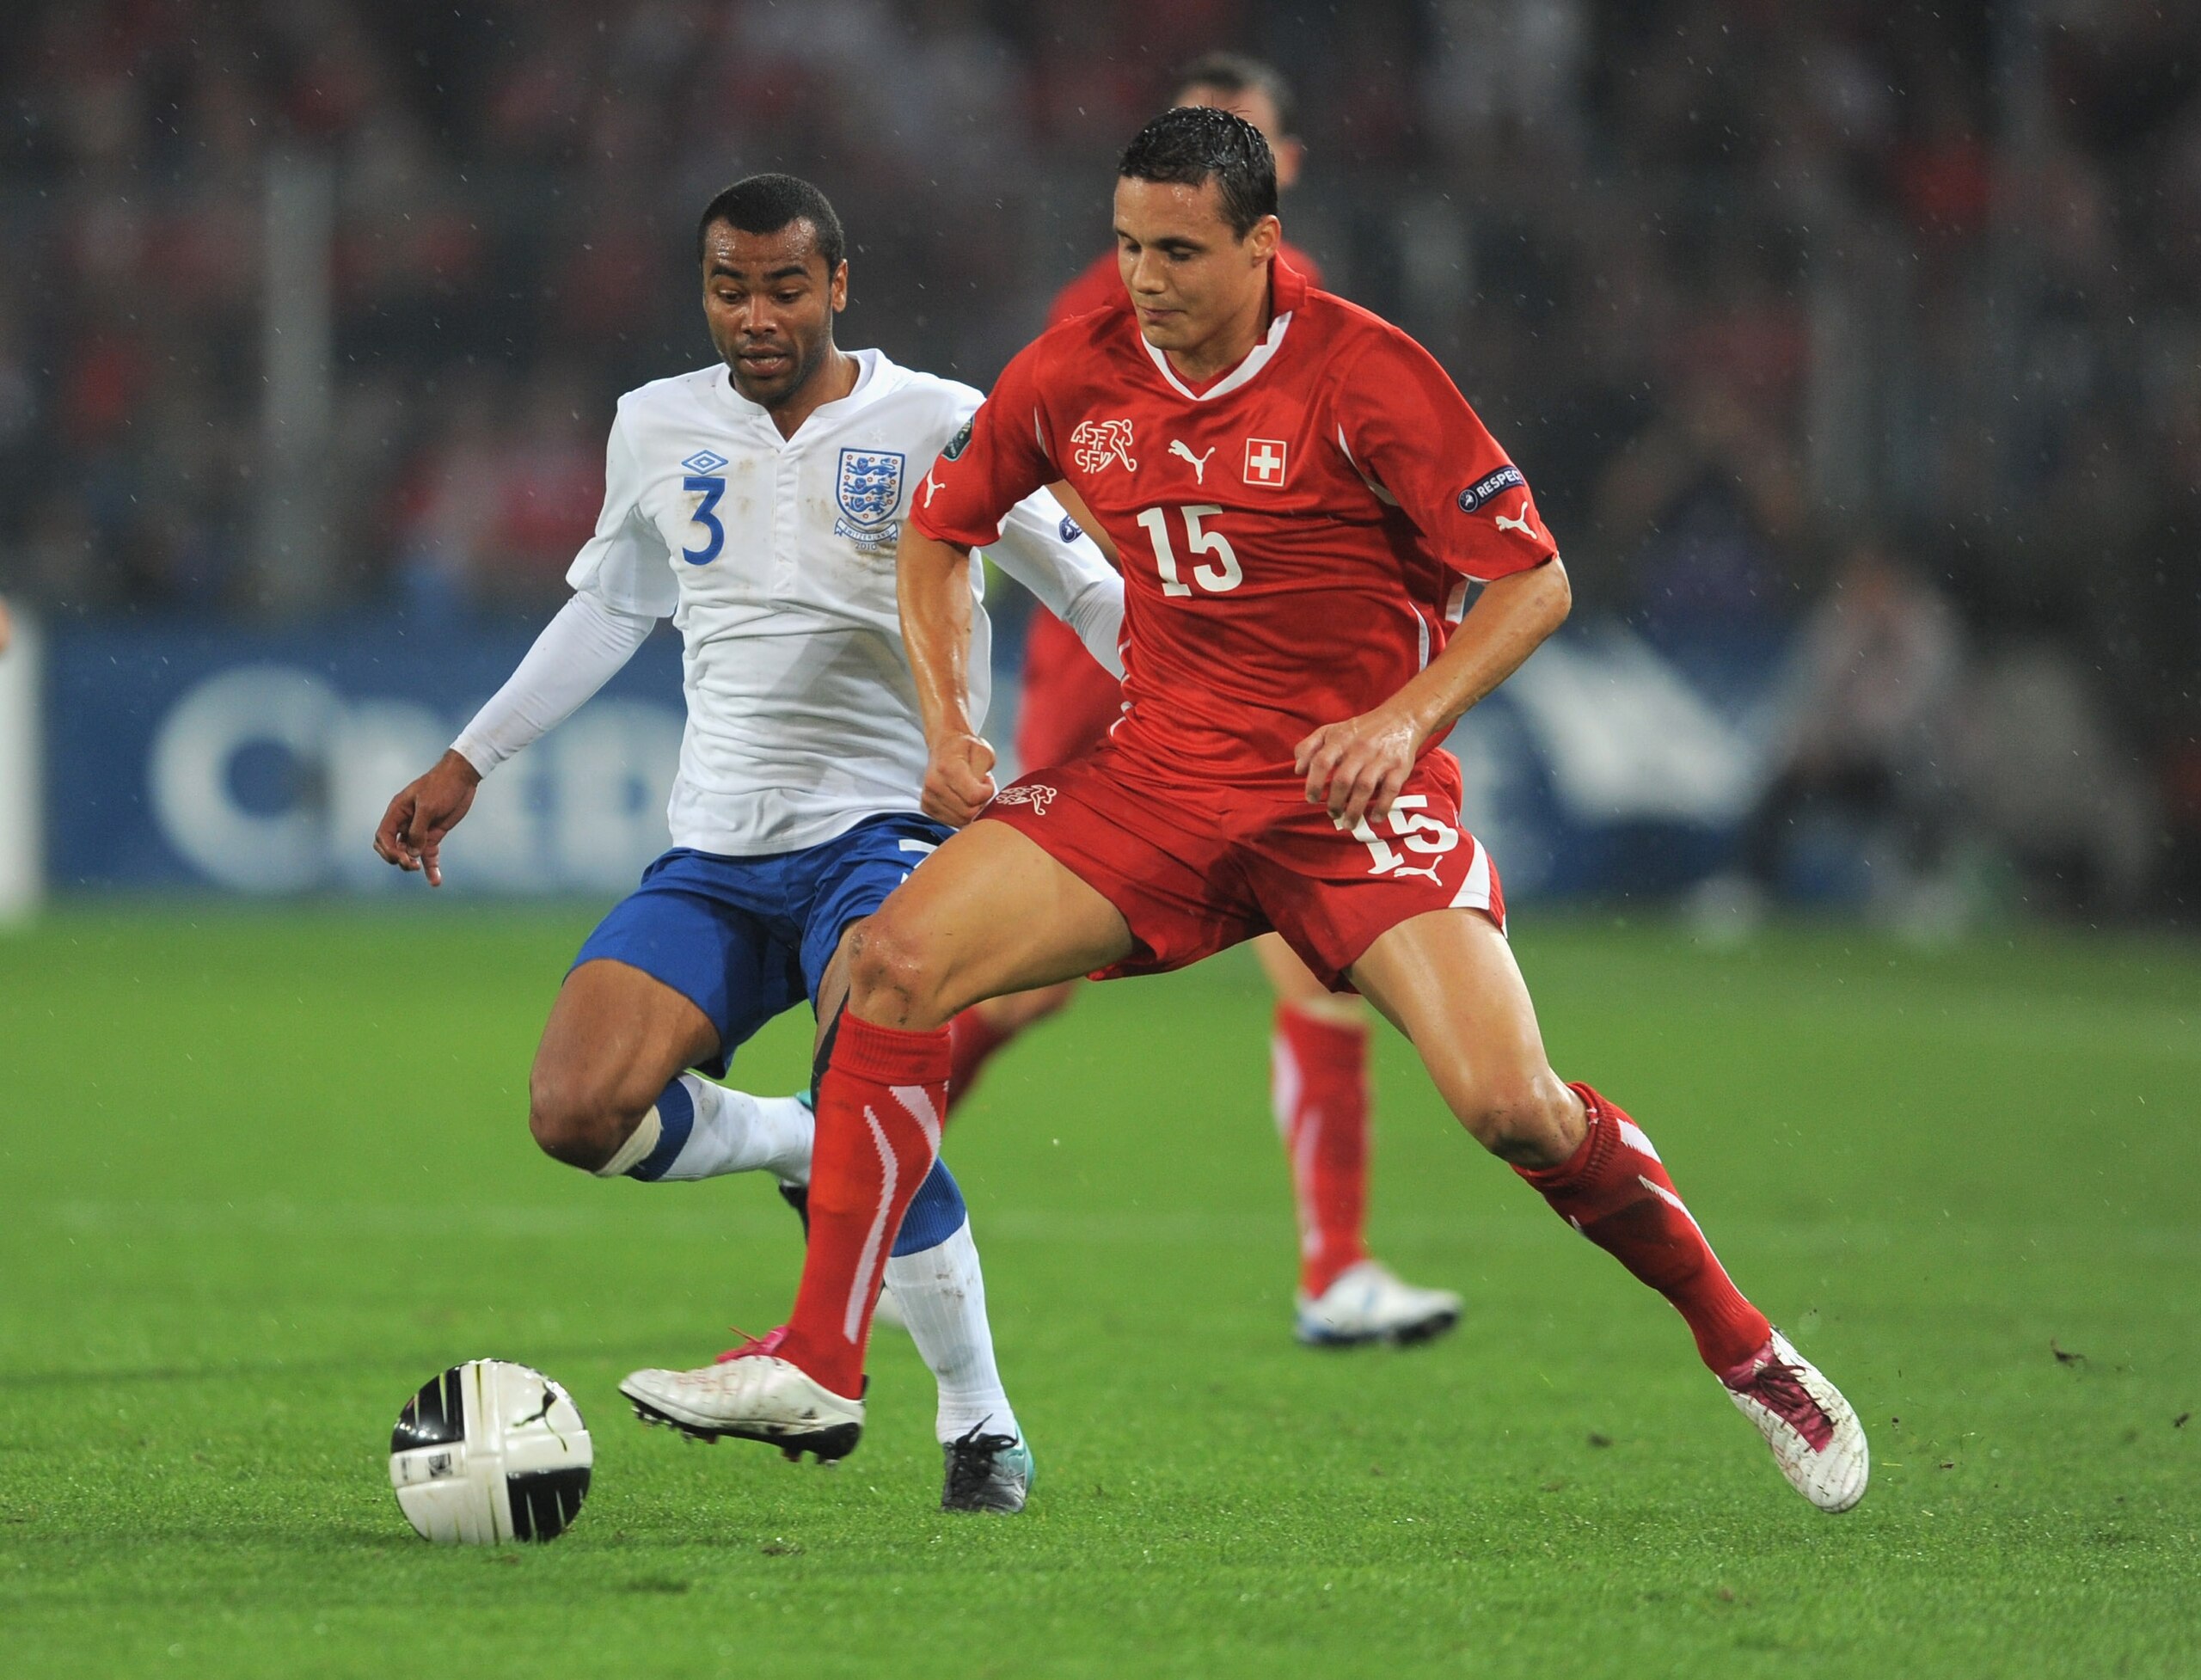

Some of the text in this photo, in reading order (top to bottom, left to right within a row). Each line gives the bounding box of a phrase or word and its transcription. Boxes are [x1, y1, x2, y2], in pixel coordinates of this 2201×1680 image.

[682, 476, 726, 566] 3
[1476, 469, 1522, 498] RESPEC
[1137, 504, 1243, 597] 15
[1333, 794, 1459, 874] 15
